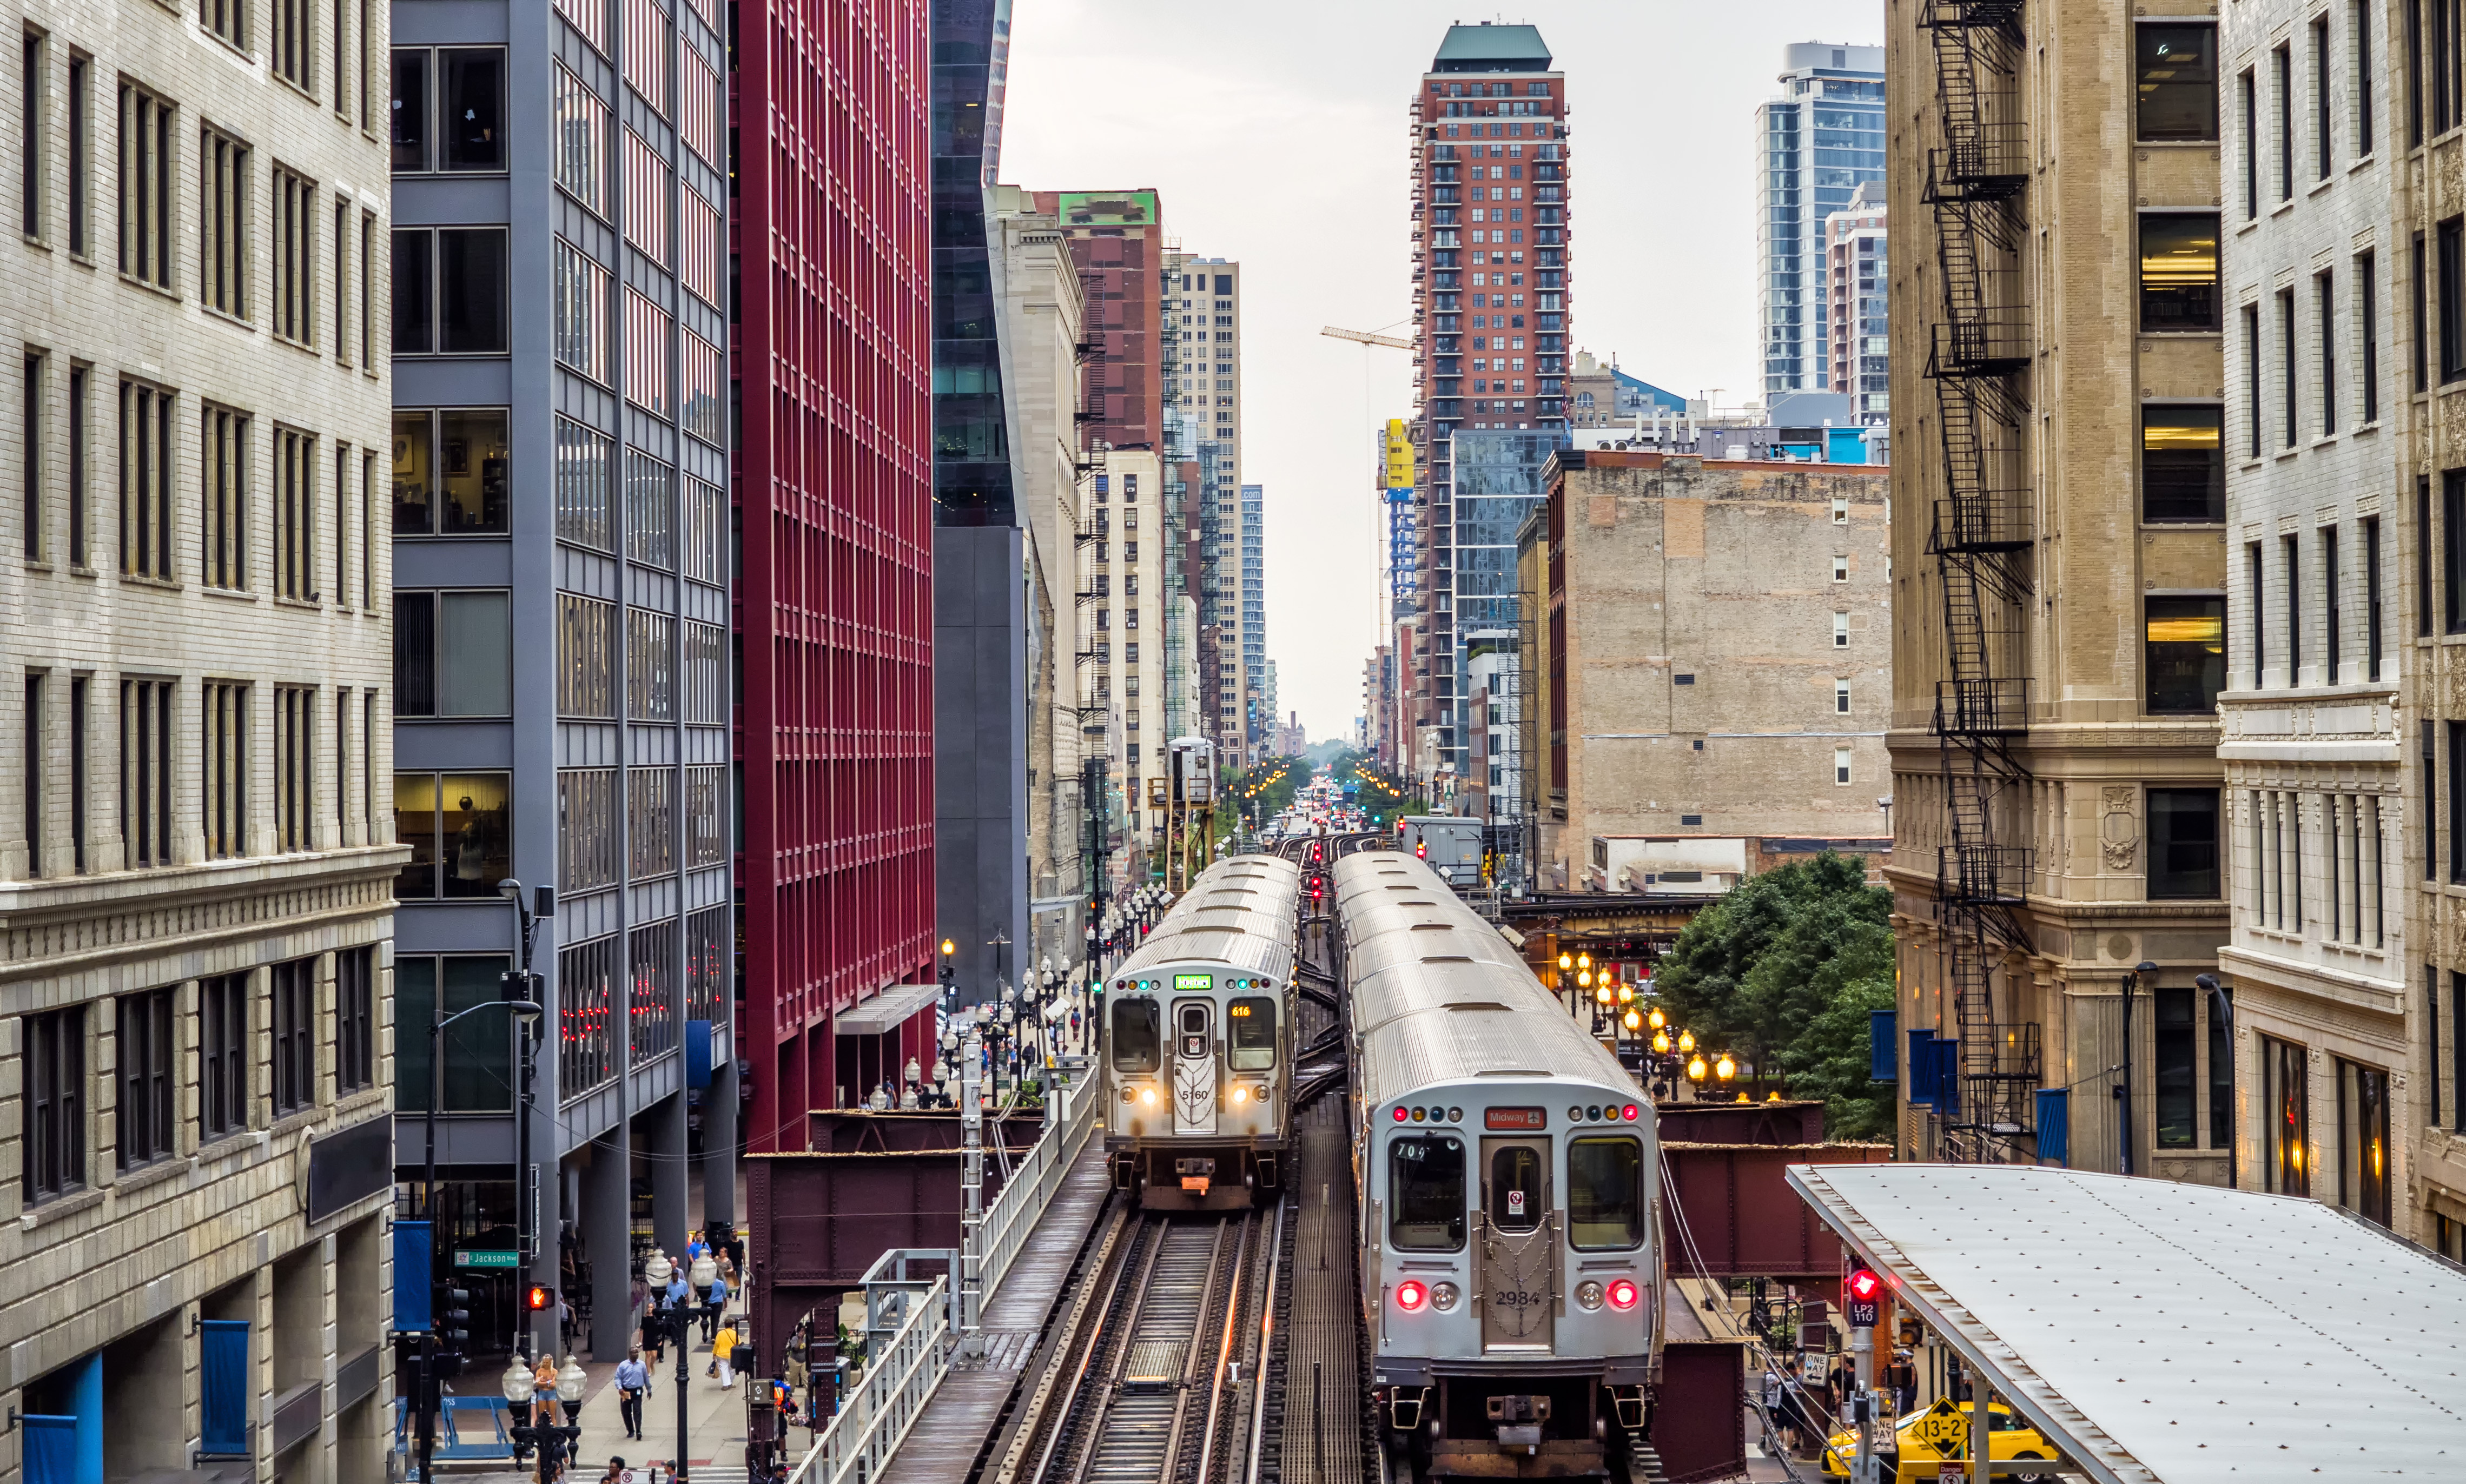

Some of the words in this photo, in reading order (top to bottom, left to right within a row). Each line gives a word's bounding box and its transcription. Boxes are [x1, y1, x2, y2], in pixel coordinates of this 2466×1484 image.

[1232, 1006, 1251, 1016] 616
[1182, 1090, 1208, 1100] 5160
[1490, 1113, 1525, 1123] Midway
[475, 1254, 506, 1262] Jackson
[1496, 1291, 1539, 1305] 2984
[1855, 1304, 1873, 1313] LP2
[1855, 1313, 1873, 1321] 110
[1808, 1355, 1825, 1364] ONE
